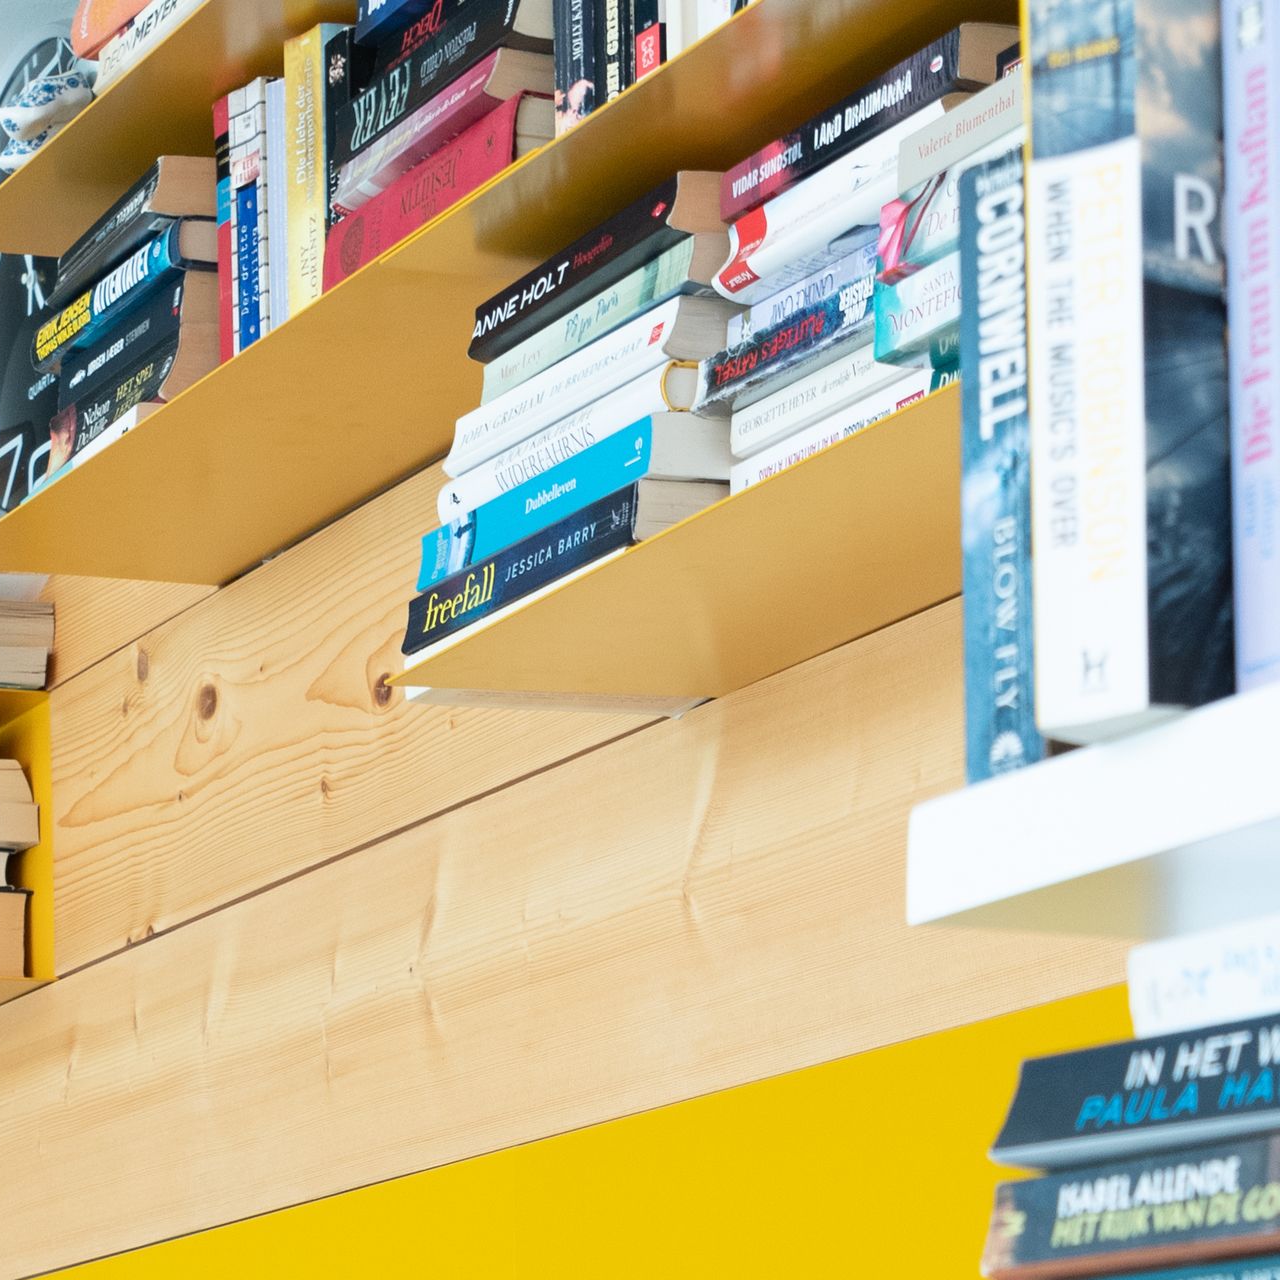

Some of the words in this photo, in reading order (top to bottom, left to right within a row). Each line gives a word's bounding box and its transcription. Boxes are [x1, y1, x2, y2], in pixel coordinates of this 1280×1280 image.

[350, 59, 412, 152] FEVER
[917, 129, 953, 161] Valerie
[954, 89, 1016, 139] Blumenthal
[1237, 64, 1269, 215] Kaftan
[1044, 179, 1072, 264] WHEN
[1240, 218, 1270, 281] im
[472, 294, 521, 340] ANNE
[518, 260, 570, 311] HOLT
[922, 269, 955, 297] SANTA
[975, 183, 1028, 442] CORNWELL
[1047, 275, 1074, 330] THE
[1242, 283, 1271, 391] Frau
[460, 422, 491, 449] JOHN
[489, 390, 546, 433] GRISHAM
[524, 476, 578, 515] Dubbelleven
[1050, 476, 1079, 550] OVER
[422, 562, 496, 633] freefall
[504, 542, 555, 583] JESSICA
[556, 521, 599, 556] BARRY
[991, 515, 1019, 632] BLOW
[993, 643, 1020, 711] FLY
[1123, 1046, 1167, 1092] IN
[1171, 1030, 1255, 1084] HET
[1075, 1081, 1200, 1132] PAULA
[1218, 1067, 1280, 1110] HA
[1056, 1168, 1136, 1220] ISABEL
[1135, 1155, 1242, 1207] ALLENDE
